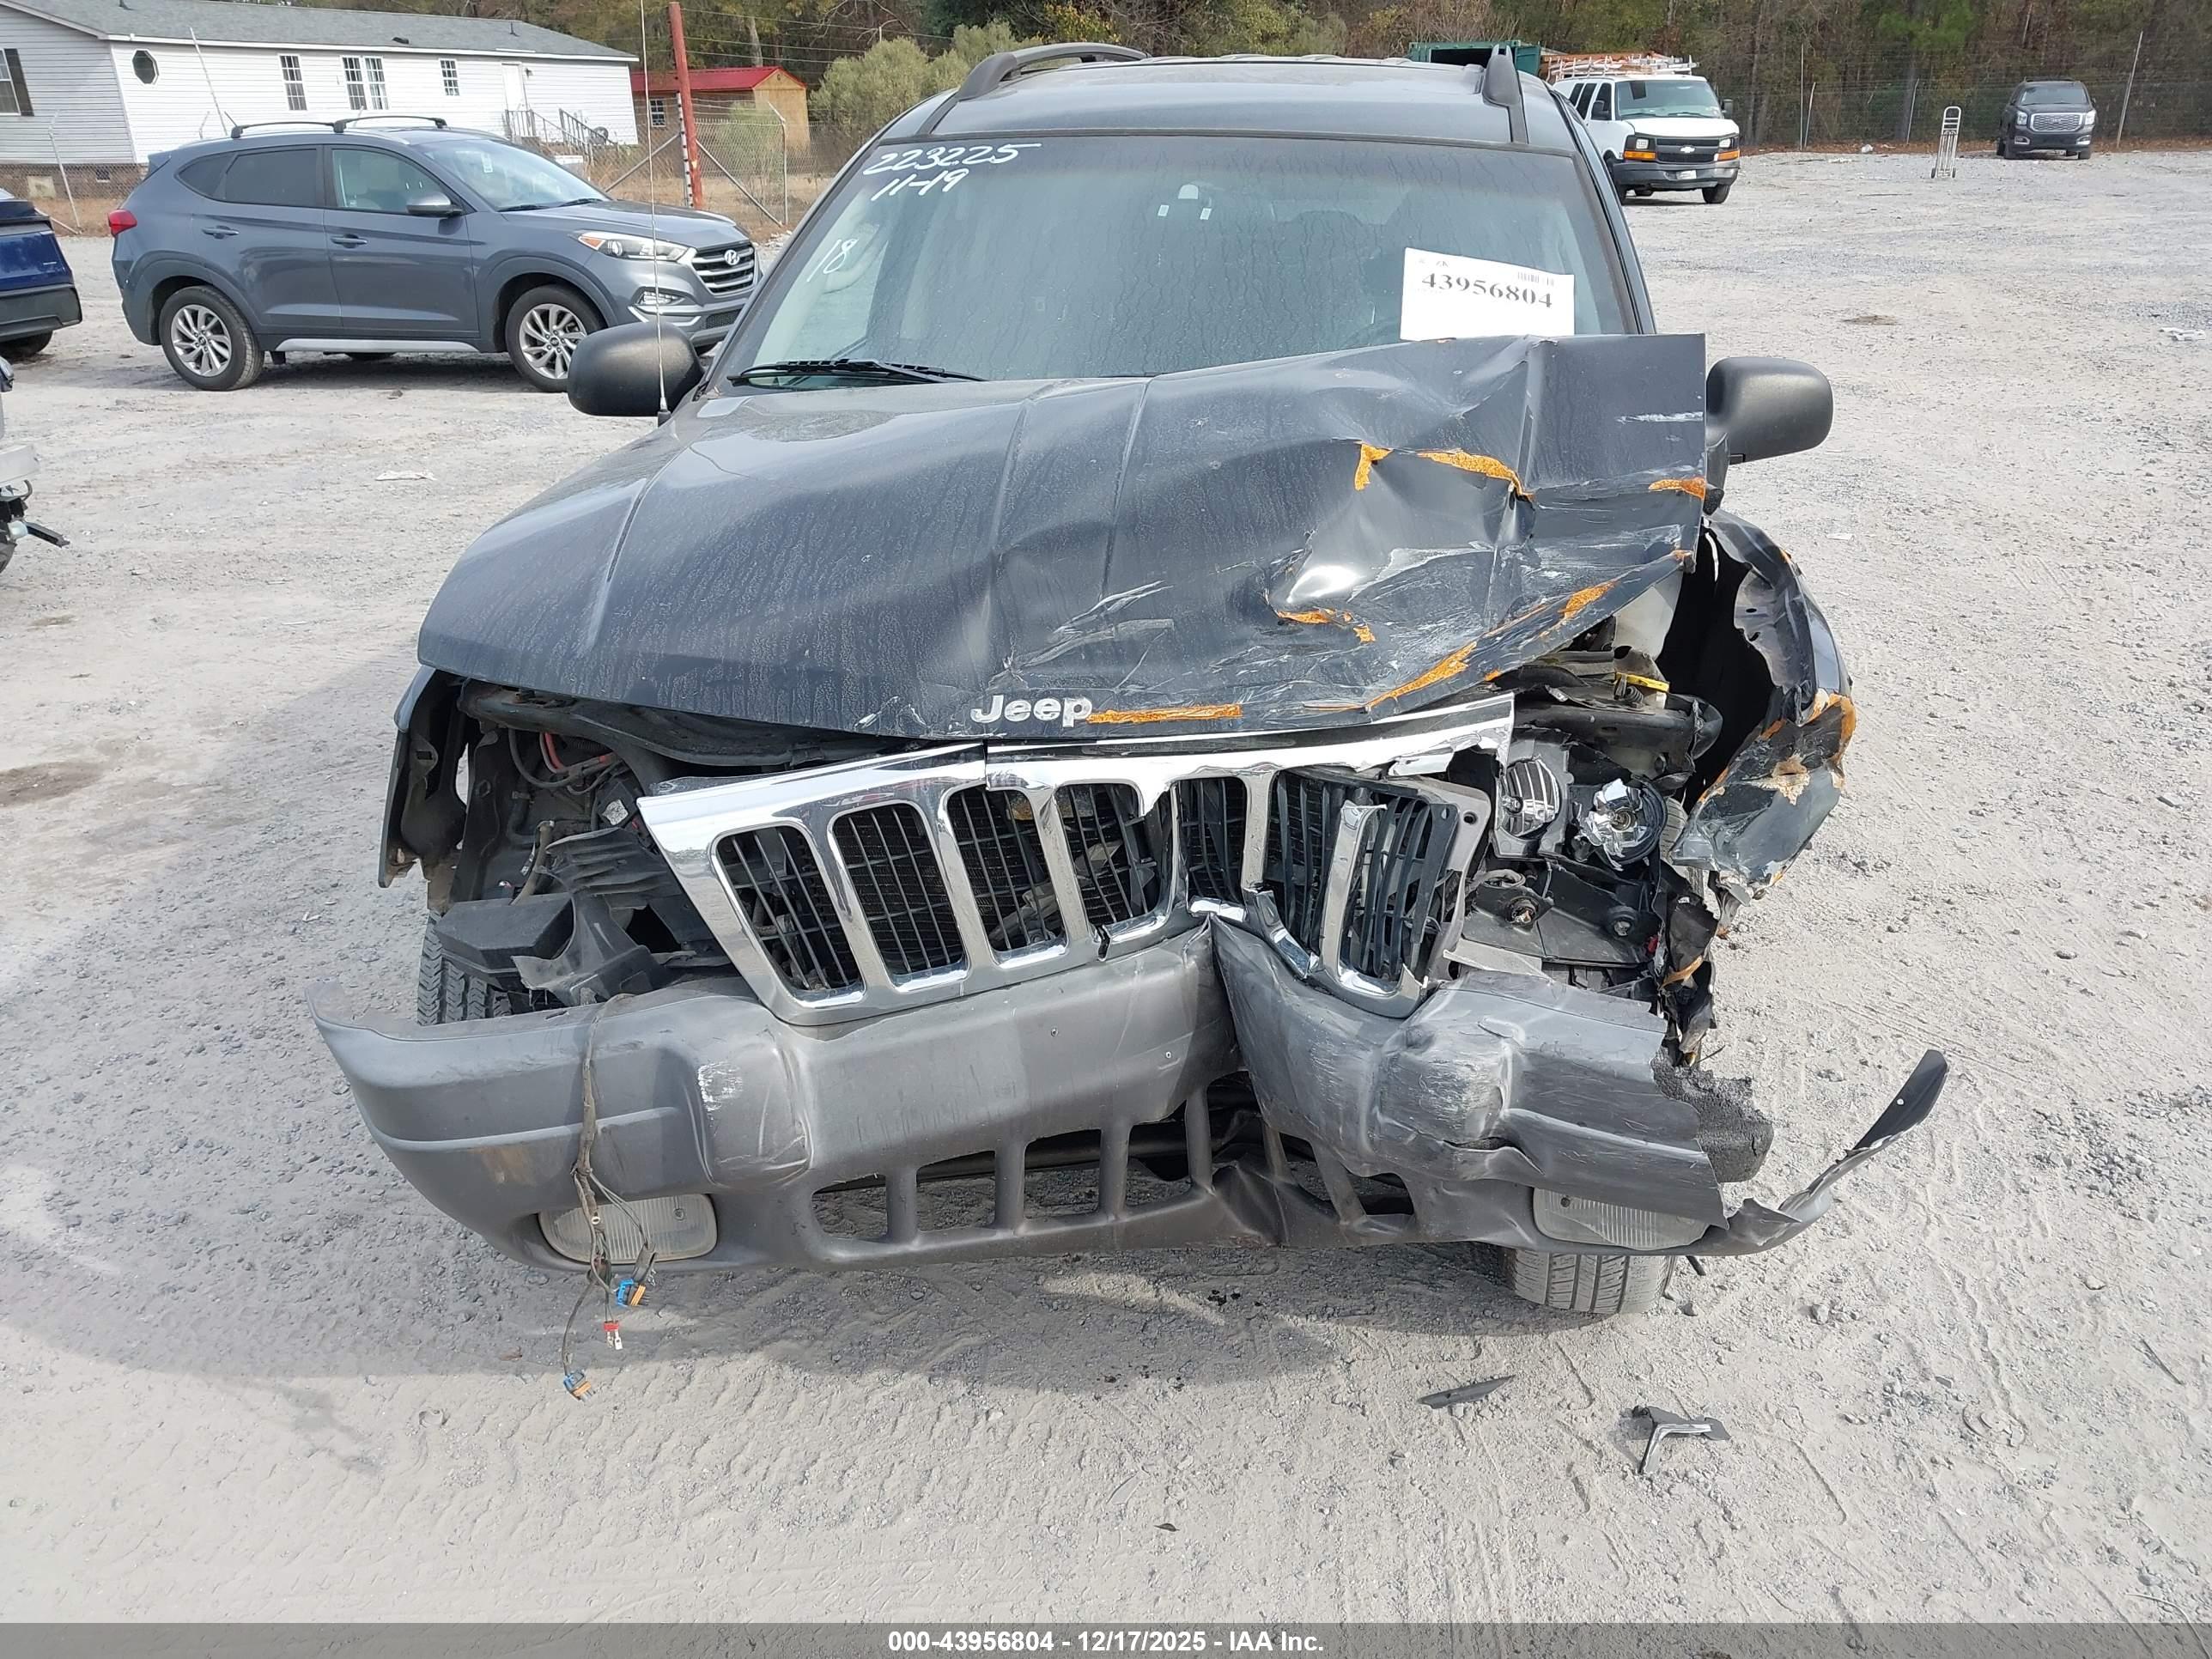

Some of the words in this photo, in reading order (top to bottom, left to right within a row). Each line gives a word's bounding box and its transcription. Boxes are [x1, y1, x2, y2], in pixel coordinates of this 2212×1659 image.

[863, 143, 1042, 175] 223225
[871, 168, 969, 201] 11-19
[1422, 273, 1552, 307] 43956804
[969, 695, 1093, 728] Jeep
